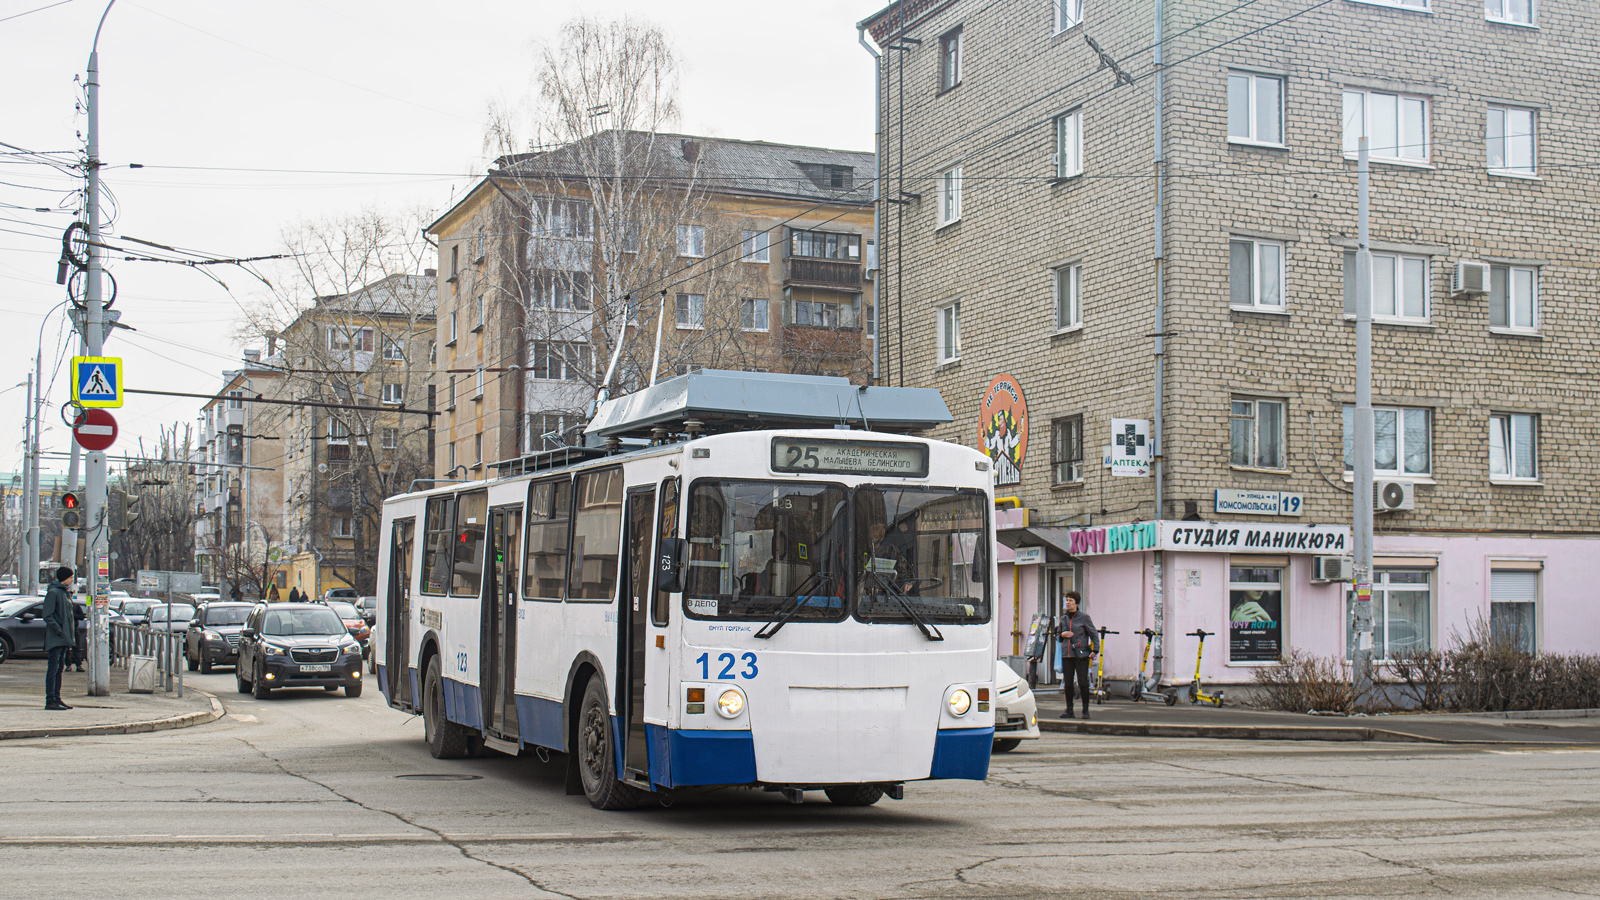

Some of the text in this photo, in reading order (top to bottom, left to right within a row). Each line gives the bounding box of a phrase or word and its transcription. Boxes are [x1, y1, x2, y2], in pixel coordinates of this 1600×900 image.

[986, 381, 1018, 408] НЕ ТЕРЯЙСЯ
[786, 446, 897, 469] 25 АКАДЕМИЧЕСКАЯ
[824, 457, 911, 468] МАЛЫШЕВА БЕЛИНСКОГО
[1219, 501, 1276, 511] КОМСОМОЛЬСКАЯ
[1283, 496, 1300, 512] 19
[1070, 522, 1156, 554] ХОЧУ НОГТИ
[1173, 528, 1345, 550] СТУДИЯ МАНИКЮРА
[661, 554, 671, 571] 123
[695, 600, 717, 608] ДЕПО
[1251, 620, 1277, 629] НОГТИ
[457, 652, 467, 672] 123
[696, 652, 758, 680] 123
